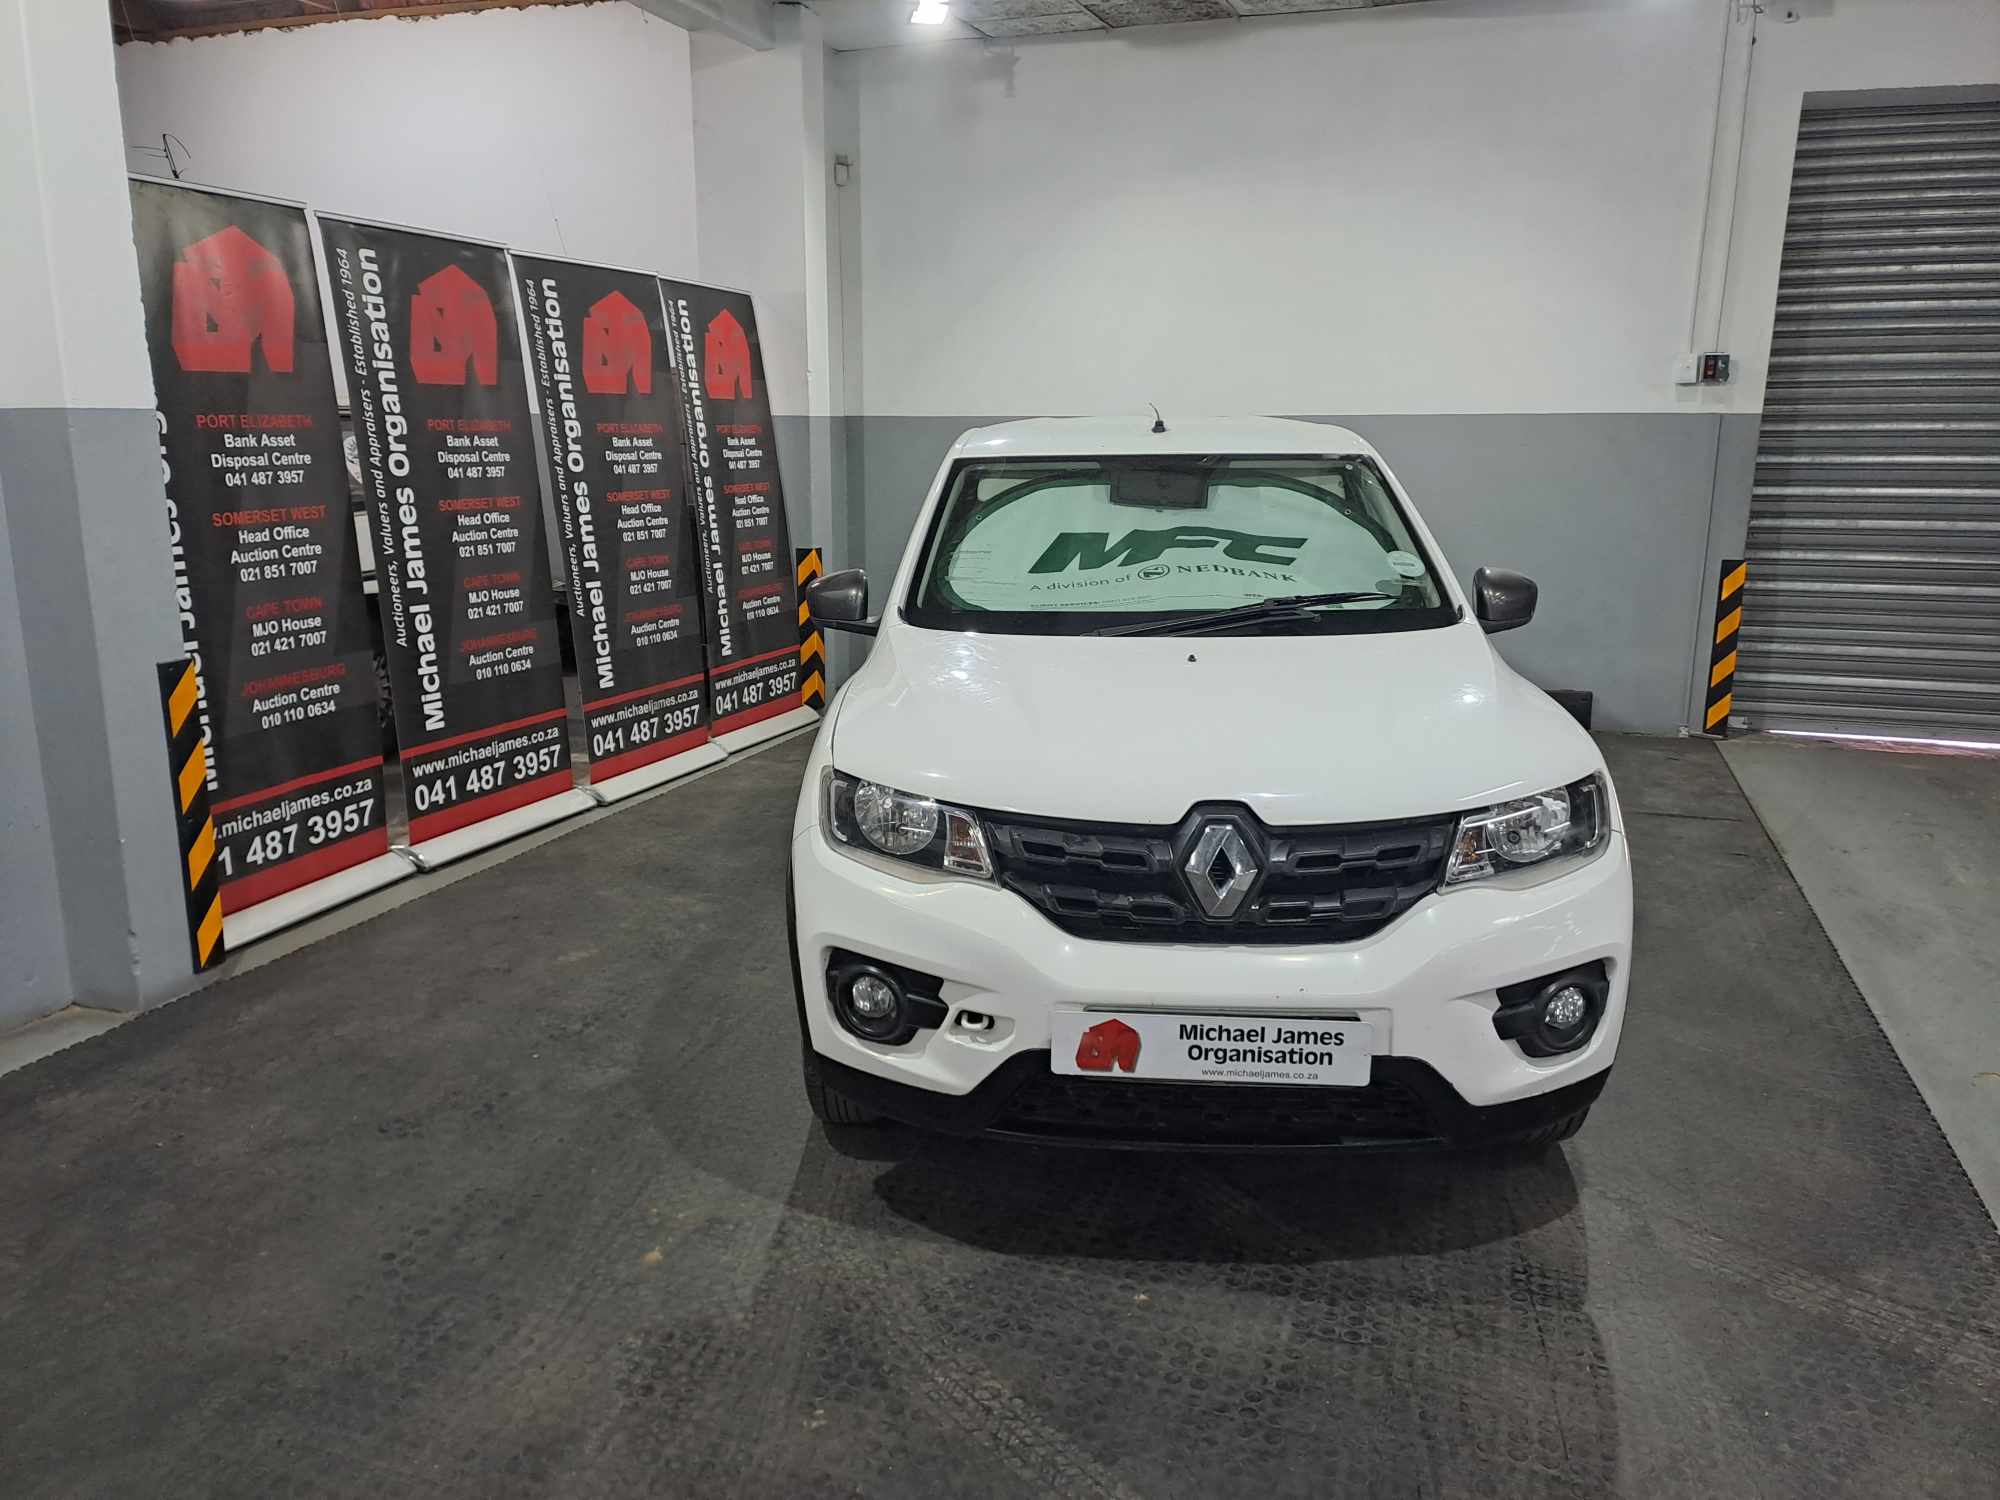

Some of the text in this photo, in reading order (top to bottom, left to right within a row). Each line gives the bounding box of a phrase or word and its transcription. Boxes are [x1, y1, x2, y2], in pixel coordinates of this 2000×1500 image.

[336, 247, 353, 289] 1964
[525, 279, 539, 311] 1964
[342, 289, 367, 376] Established
[530, 313, 551, 387] Established
[196, 415, 236, 428] PORT
[360, 389, 382, 467] Appraisers
[545, 398, 563, 465] Appraisers
[224, 434, 296, 447] Bank Asset
[446, 435, 499, 447] Bank Asset
[612, 436, 631, 447] Bank
[211, 452, 312, 470] Disposal Centre
[437, 450, 511, 465] Disposal Centre
[605, 450, 663, 462] Disposal Centre
[225, 470, 304, 487] 041 487 3957
[447, 466, 505, 479] 041 487 3957
[554, 465, 567, 491] and
[642, 463, 658, 473] 3957
[677, 299, 732, 657] Michael James Organisation
[358, 248, 446, 732] Michael James Organisation
[370, 468, 386, 499] and
[541, 278, 615, 689] Michael James Organisation
[212, 505, 327, 527] SOMERSET WEST
[457, 512, 510, 526] Head Office
[560, 493, 574, 539] Valuers
[621, 503, 662, 515] Head Office
[378, 502, 395, 555] Valuers
[617, 516, 669, 529] Auction Centre
[238, 526, 310, 544] Head Office
[452, 527, 519, 543] Auction Centre
[230, 544, 322, 565] Auction Centre
[459, 541, 516, 558] 021 851 7007
[1027, 526, 1308, 574] MFC
[240, 560, 317, 583] 021 851 7007
[568, 543, 585, 617] Auctioneers,
[646, 569, 669, 579] House
[1030, 564, 1298, 592] A division of NEDBANK
[468, 588, 520, 604] MJO House
[629, 584, 642, 595] 021
[643, 581, 655, 592] 421
[387, 561, 408, 648] Auctioneers,
[467, 601, 524, 620] 021 421 7007
[252, 616, 322, 637] MJO House
[630, 622, 657, 635] Auction
[251, 631, 327, 657] 021 421 7007
[468, 645, 534, 667] Auction Centre
[476, 659, 532, 681] 010 110 0634
[252, 683, 340, 713] Auction Centre
[715, 671, 797, 715] 041 487 3957
[261, 700, 336, 729] 010 110 0634
[590, 689, 699, 728] www.michaeljames.co.za
[593, 704, 700, 757] 041 487 3957
[412, 726, 560, 778] www.michaeljames.co.za
[414, 744, 561, 811] 041 487 3957
[246, 823, 298, 866] 487
[307, 798, 375, 845] 3957
[1179, 1023, 1345, 1046] Michael James
[1187, 1044, 1333, 1065] Organisation
[1201, 1068, 1319, 1080] www.michaeljames.co.za
